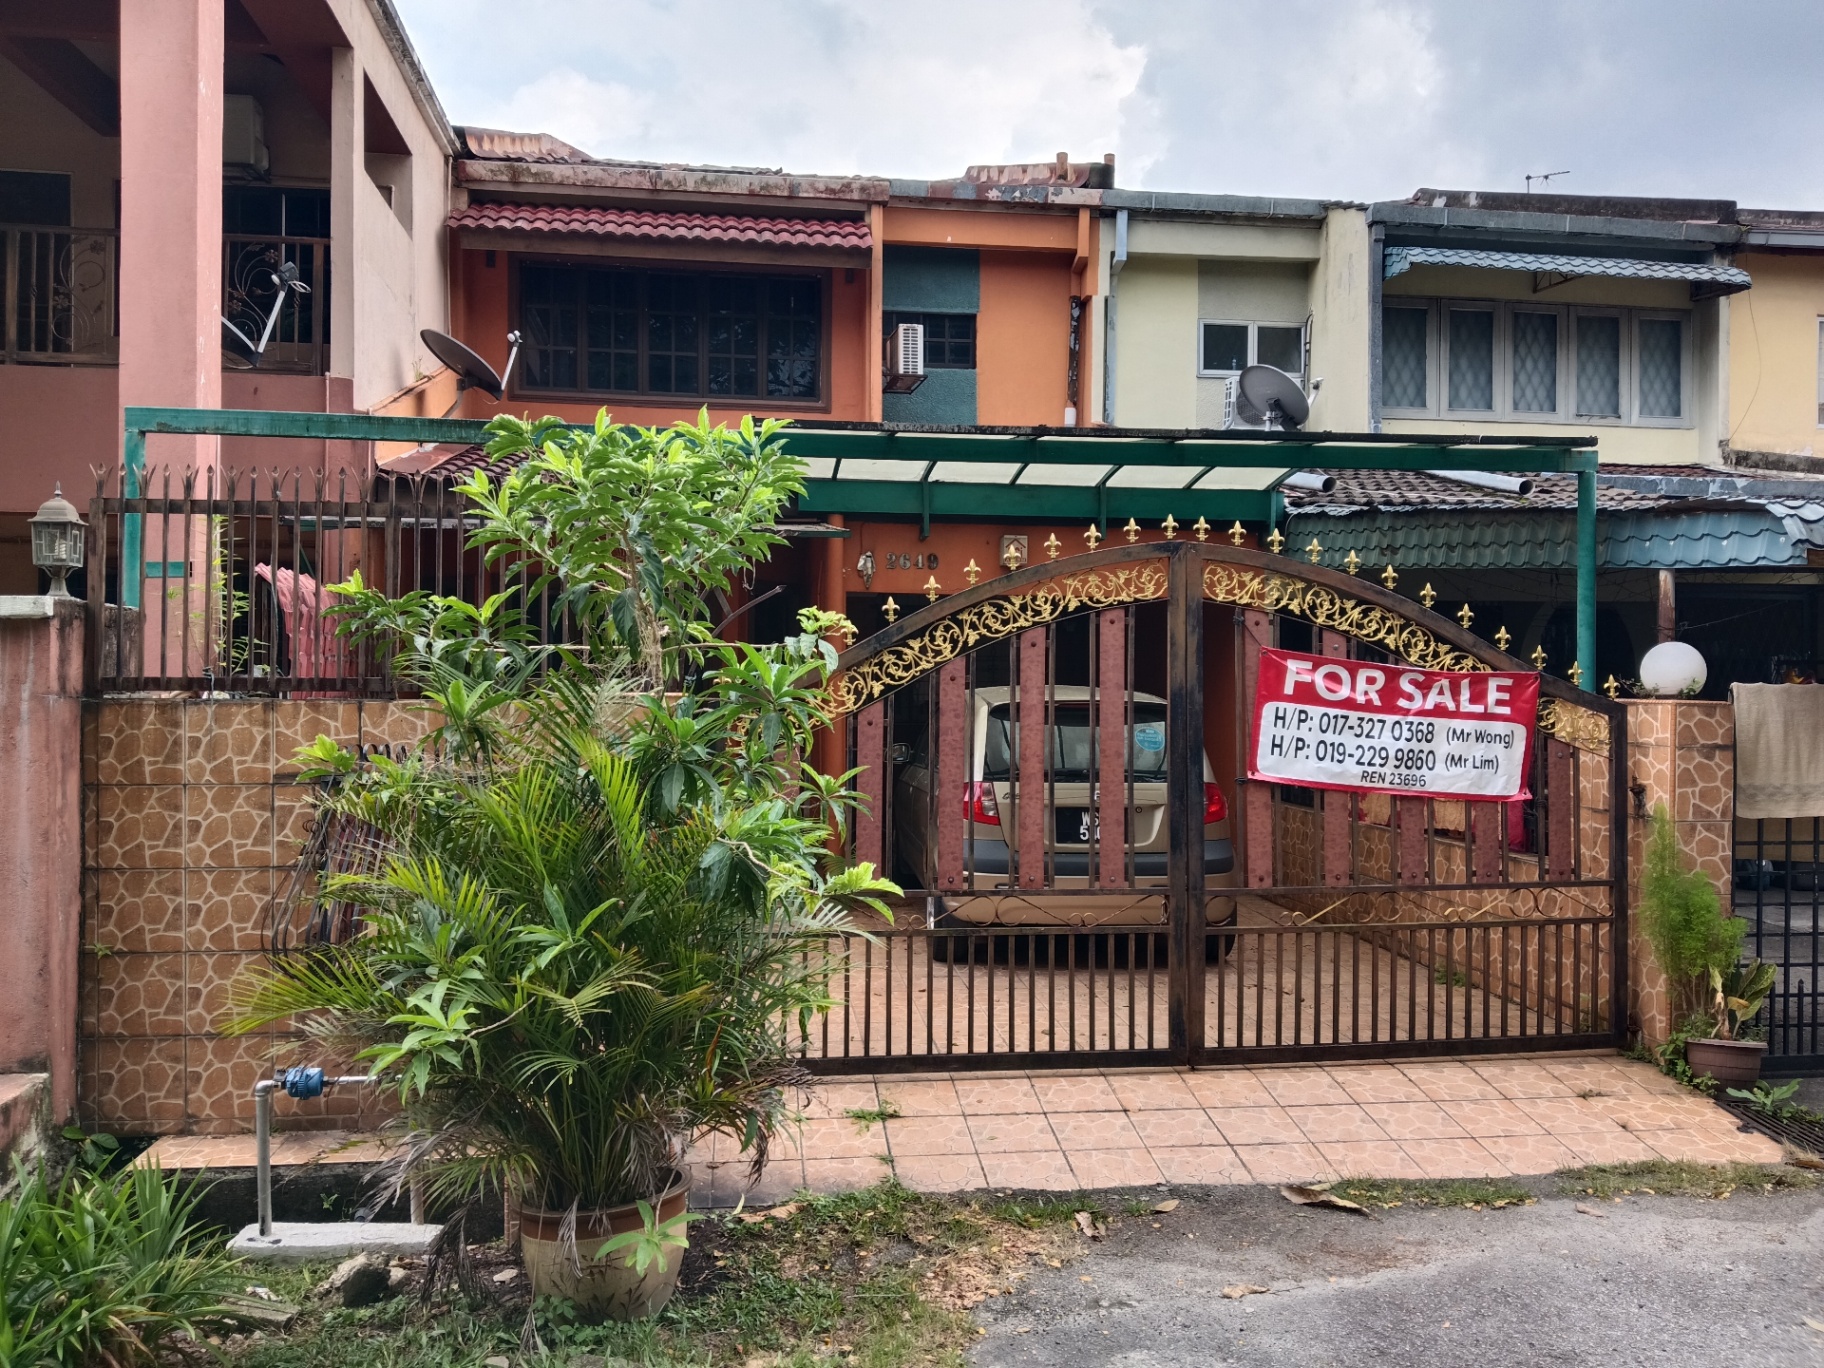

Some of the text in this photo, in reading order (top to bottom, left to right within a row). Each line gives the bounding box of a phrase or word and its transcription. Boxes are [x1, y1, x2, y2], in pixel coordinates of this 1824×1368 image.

[1283, 658, 1514, 715] FOR SALE
[1273, 706, 1514, 749] H/P: 017-327 0368 (Mr Wong)
[1270, 734, 1499, 774] H/P: 019-229 9860 (Mr Lim)
[1360, 768, 1427, 787] REN 23696
